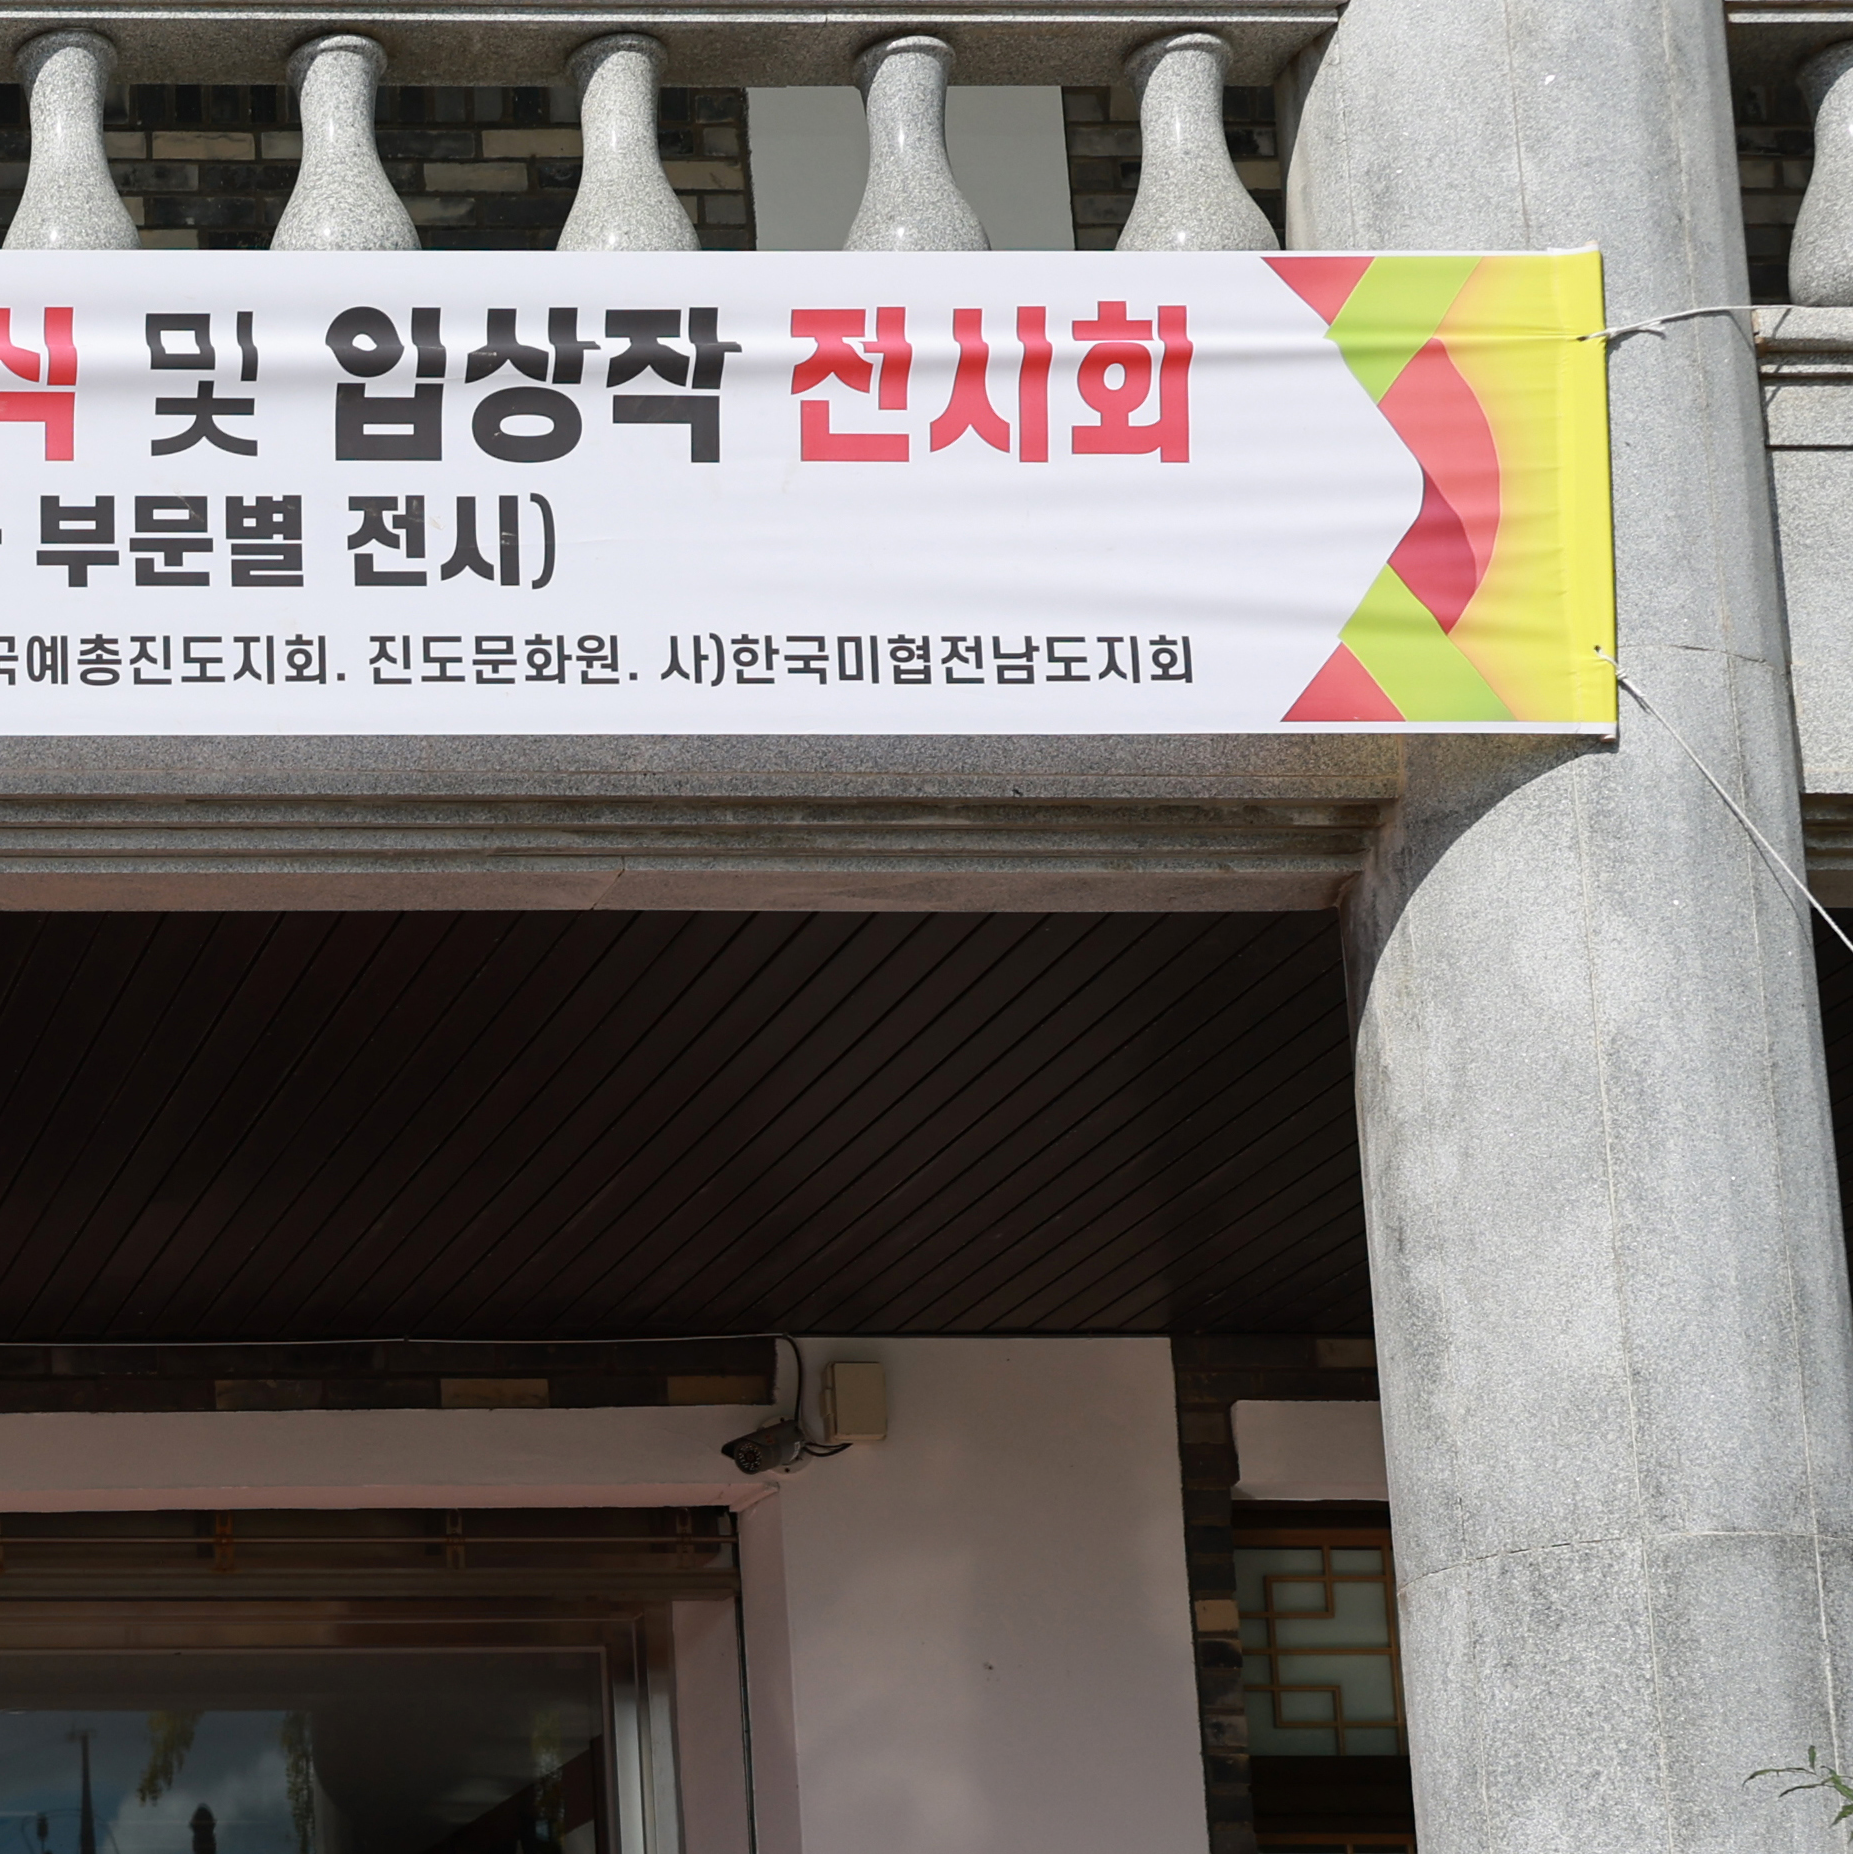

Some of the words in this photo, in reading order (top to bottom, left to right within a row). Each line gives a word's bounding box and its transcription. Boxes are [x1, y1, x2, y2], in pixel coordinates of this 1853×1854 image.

[145, 311, 259, 457] 및
[325, 306, 742, 464] 입상작
[790, 302, 1194, 463] 전시회
[36, 494, 304, 588] 부문별
[347, 492, 556, 590] 전시)
[369, 634, 638, 685] 진도문화원.
[660, 632, 1193, 687] 사)한국미협전남도지회
